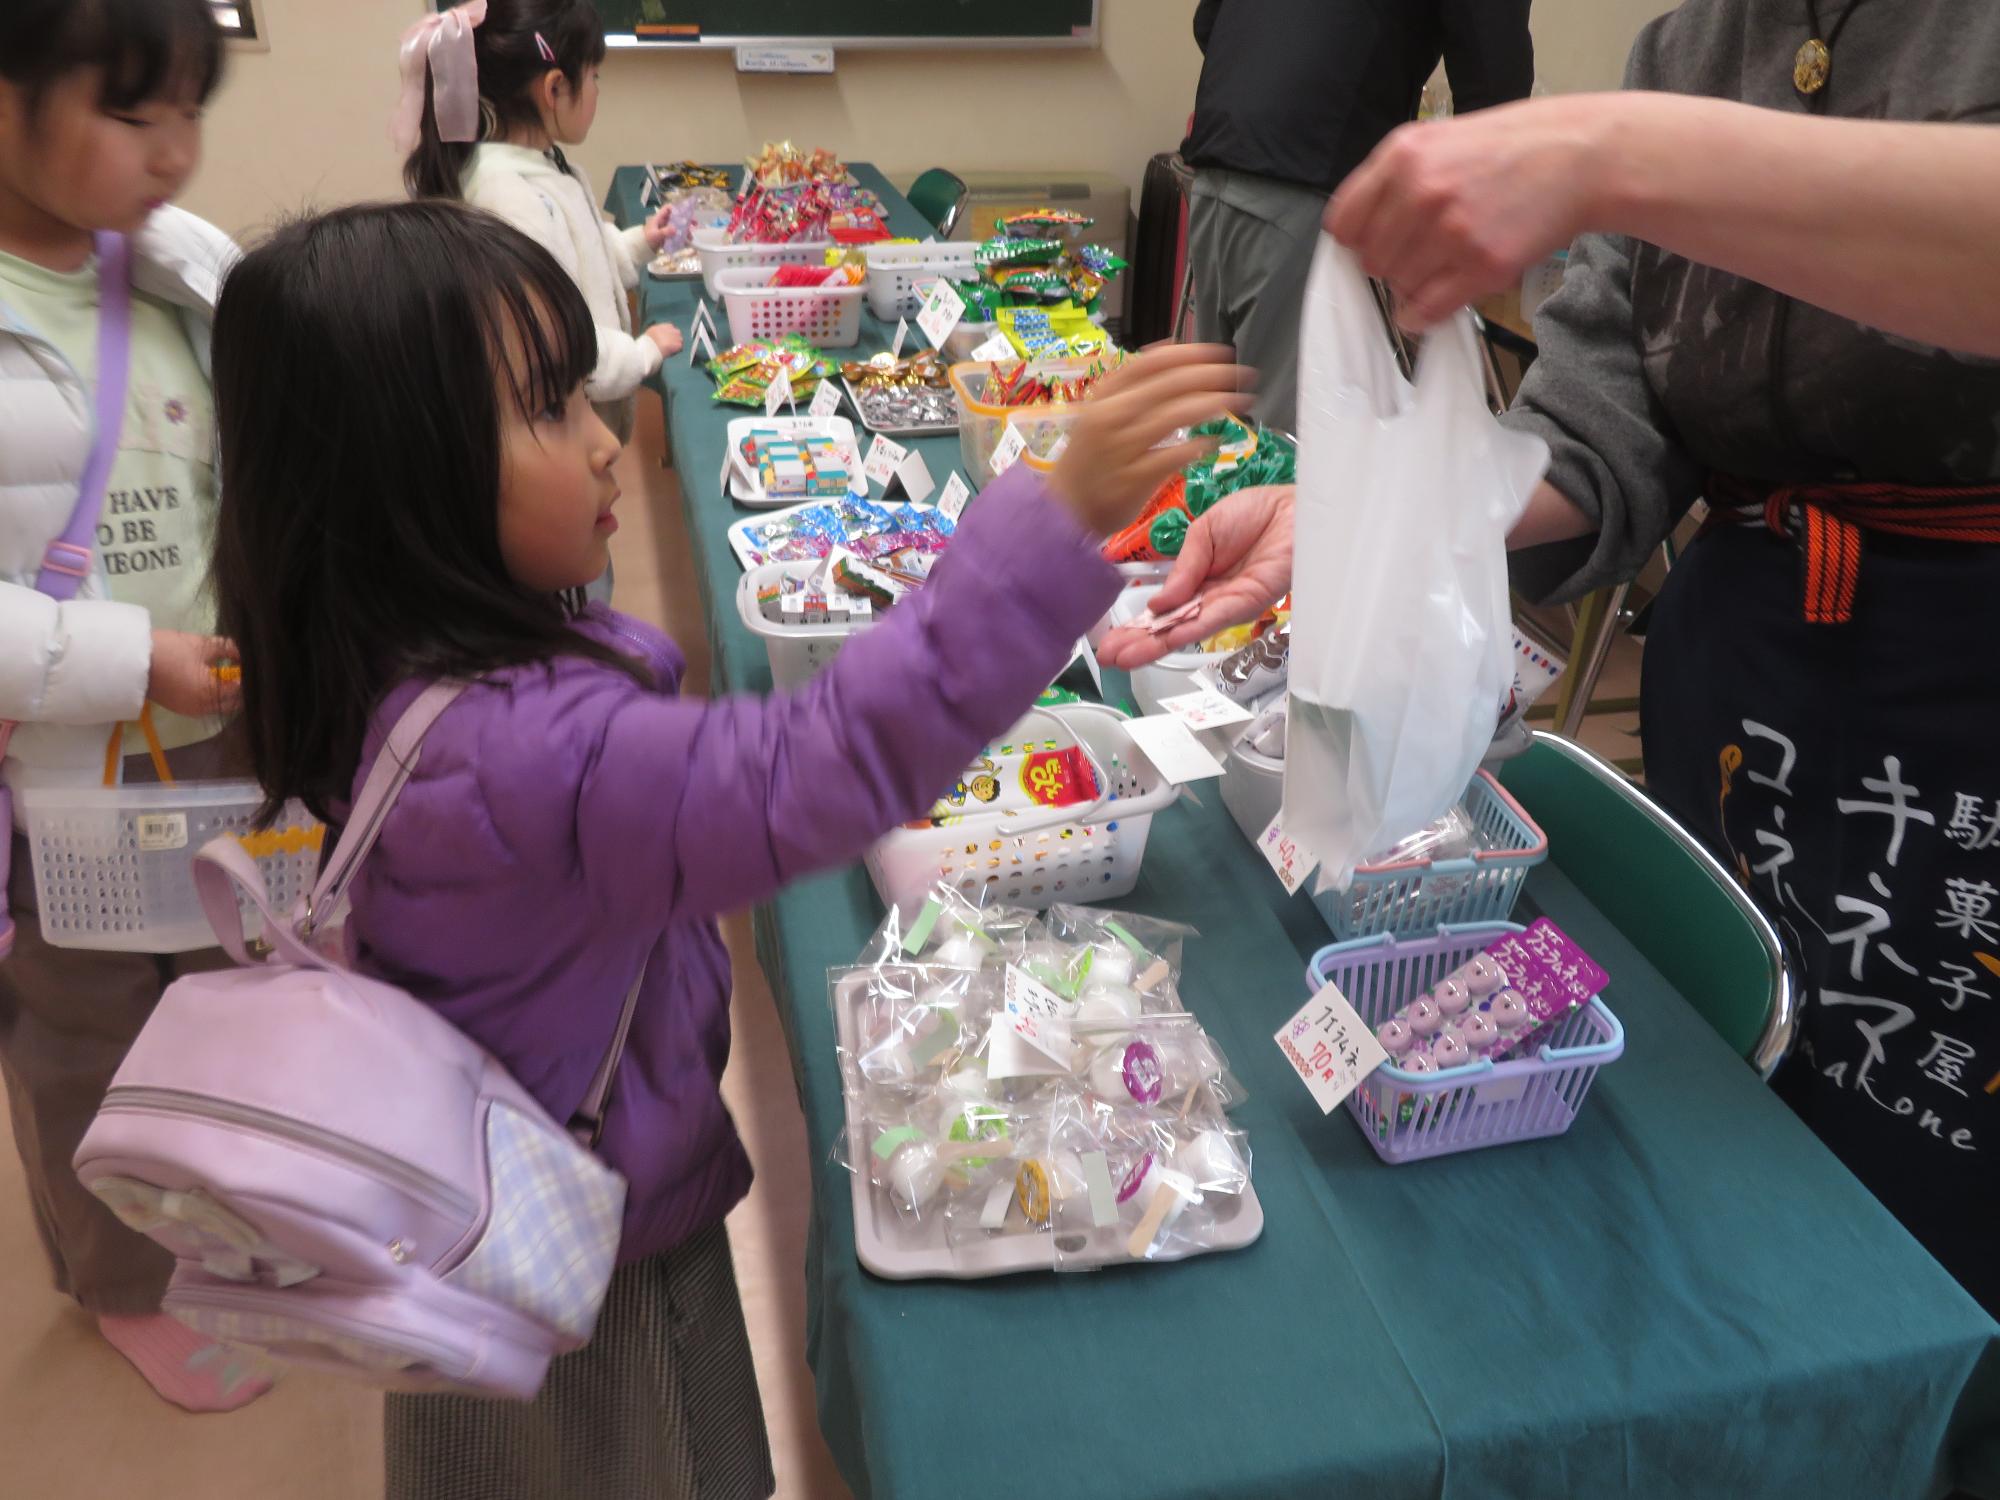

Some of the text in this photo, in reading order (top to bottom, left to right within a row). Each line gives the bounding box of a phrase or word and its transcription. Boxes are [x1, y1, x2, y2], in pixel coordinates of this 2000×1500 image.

[109, 487, 180, 514] HAVE
[121, 520, 158, 544] BE
[1819, 754, 1935, 1068] キネマ
[1917, 791, 2000, 1098] 駄菓子屋
